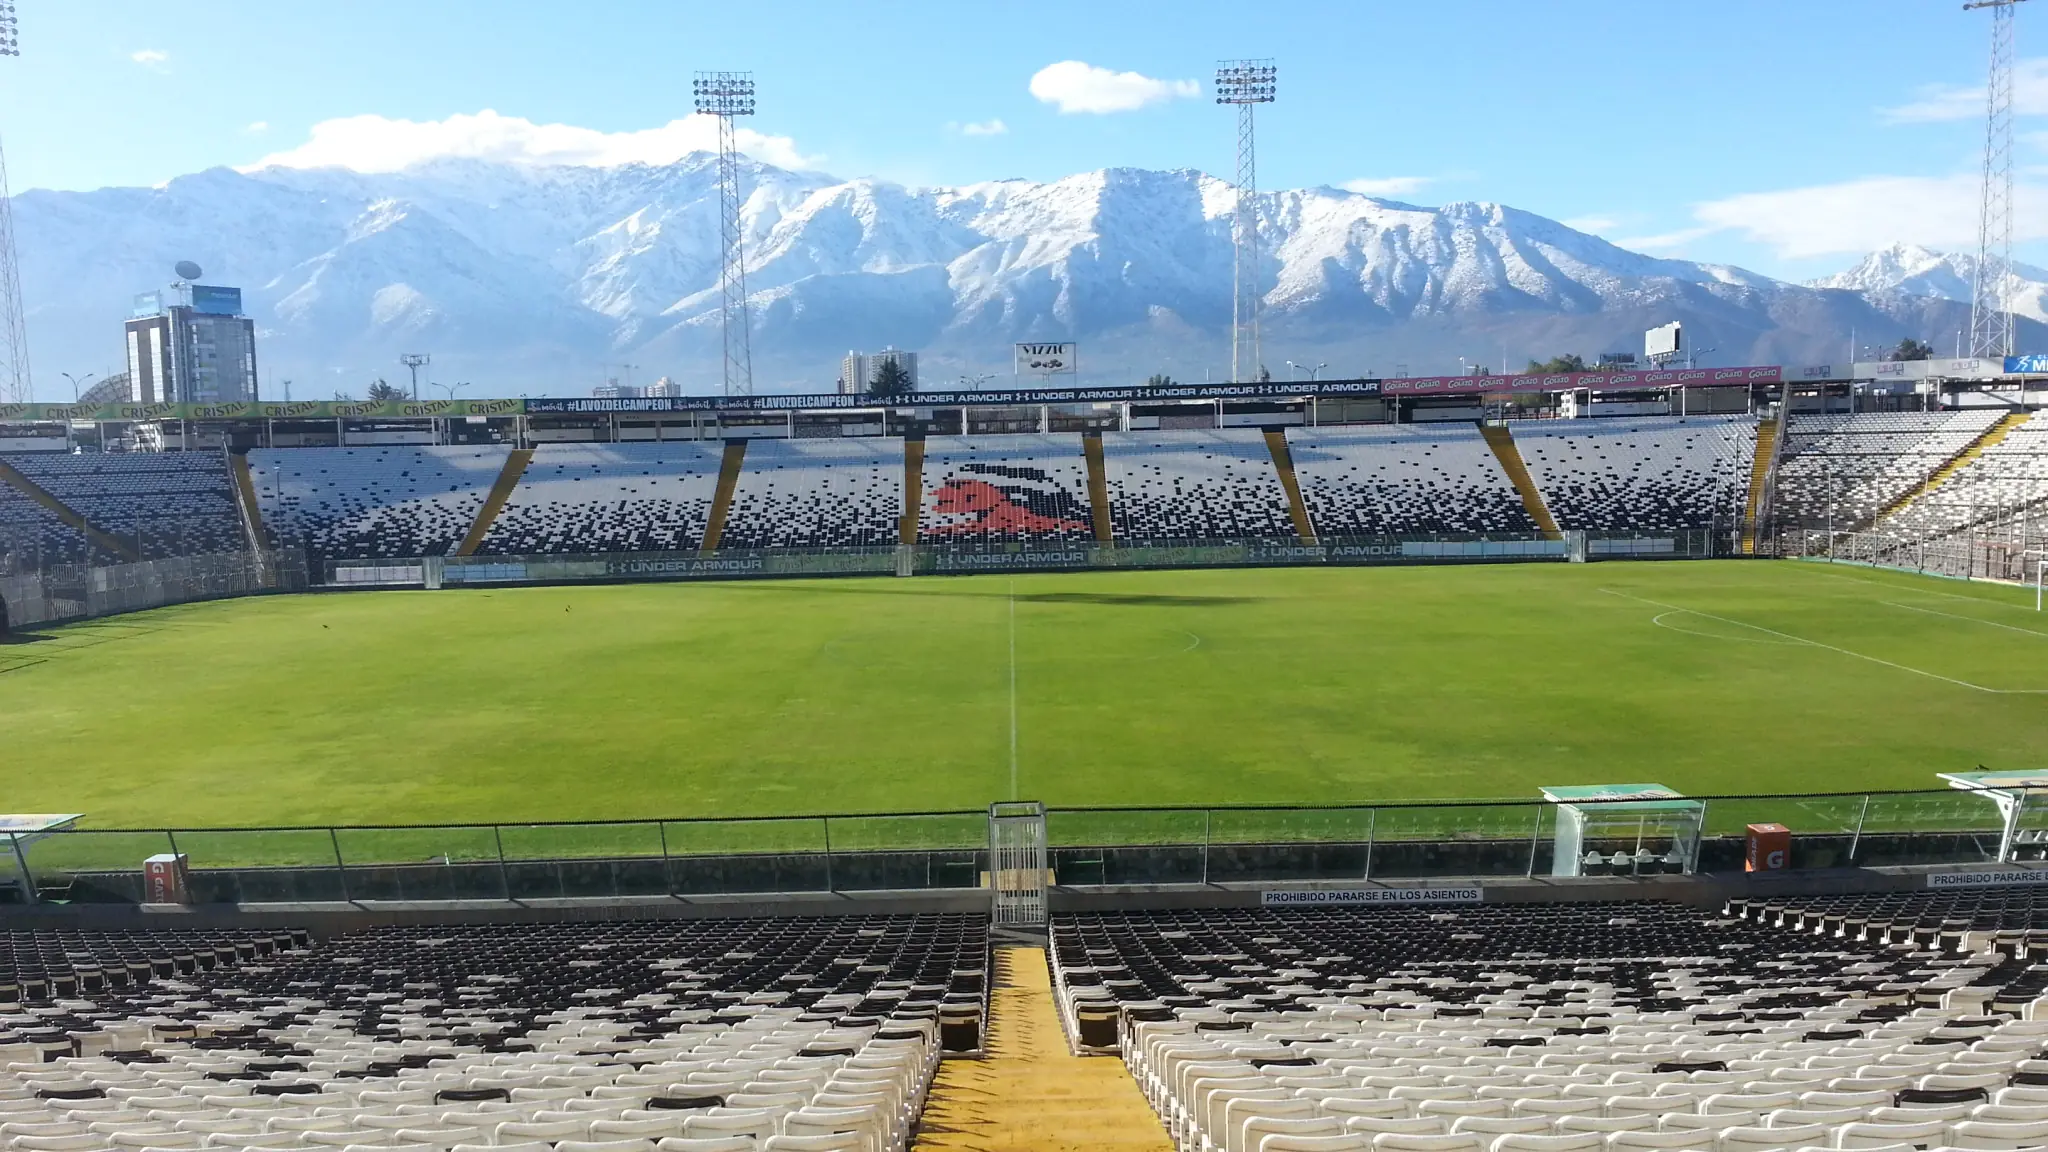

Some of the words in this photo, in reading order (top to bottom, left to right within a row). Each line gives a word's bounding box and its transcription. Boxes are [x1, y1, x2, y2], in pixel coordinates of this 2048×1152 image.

[2032, 360, 2048, 371] M
[1153, 388, 1197, 396] UNDER
[1200, 386, 1254, 396] ARMOUR
[1275, 384, 1318, 392] UNDER
[1322, 383, 1378, 392] ARMOUR
[912, 394, 954, 402] UNDER
[958, 393, 1012, 402] ARMOUR
[1032, 392, 1075, 400] UNDER
[1078, 390, 1133, 399] ARMOUR
[266, 400, 318, 416] CRISTAL
[335, 400, 385, 416] CRISTAL
[404, 400, 452, 416] CRISTAL
[470, 399, 518, 414] CRISTAL
[567, 399, 672, 412] #LAVOZDELCAMPEON
[753, 395, 855, 409] #LAVOZDELCAMPEON
[46, 402, 102, 419] CRISTAL
[121, 402, 175, 418] CRISTAL
[194, 401, 248, 417] CRISTAL
[958, 553, 1012, 564] UNDER
[1014, 552, 1084, 563] ARMOUR
[1270, 547, 1327, 557] UNDER
[630, 561, 686, 573] UNDER
[692, 559, 763, 572] ARMOUR
[1767, 850, 1784, 868] G
[152, 862, 164, 873] G
[1934, 874, 1991, 884] PROHIBIDO
[1994, 872, 2040, 882] PARARSE
[1266, 892, 1326, 902] PROHIBIDO
[1328, 891, 1379, 901] PARARSE
[1382, 890, 1397, 900] EN
[1400, 890, 1421, 900] LOS
[1424, 890, 1478, 900] ASIENTOS
